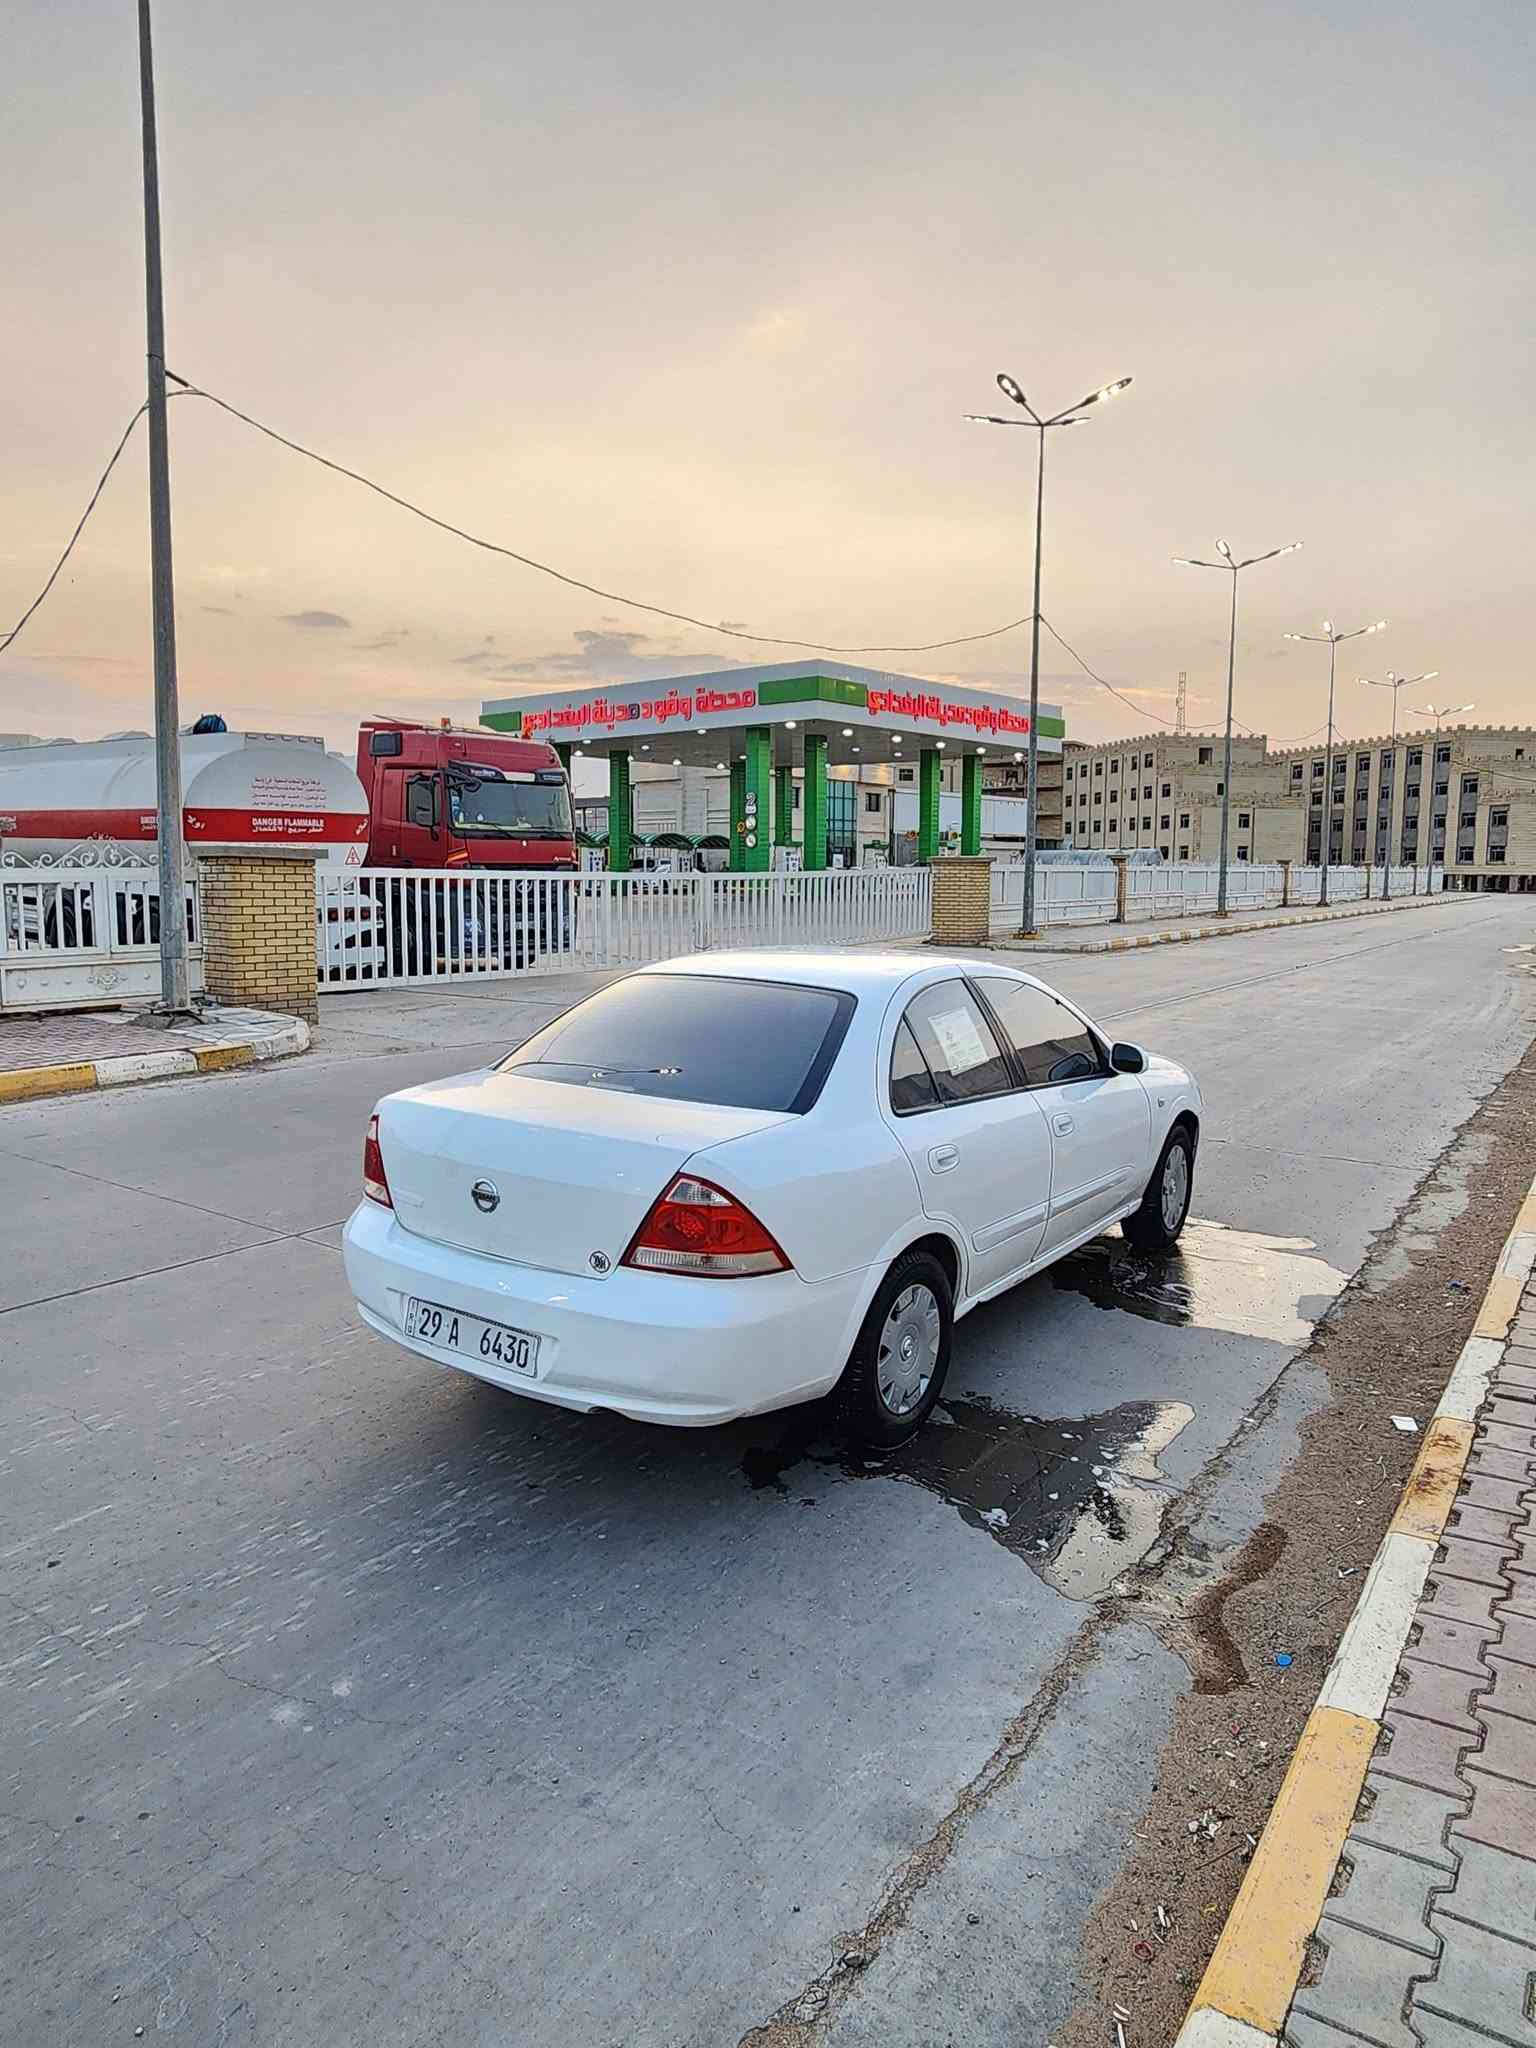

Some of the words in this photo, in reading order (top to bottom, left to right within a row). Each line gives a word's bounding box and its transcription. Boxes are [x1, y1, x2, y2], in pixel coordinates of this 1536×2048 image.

[592, 697, 640, 730] مدينة
[640, 688, 692, 723] وقود
[696, 687, 756, 713] محطة
[867, 690, 925, 721] البغدادي
[925, 695, 964, 726] مدينة
[522, 703, 591, 737] البغدادي
[964, 704, 998, 735] وقود
[999, 708, 1030, 733] محطة
[252, 818, 283, 827] DANGER
[284, 818, 324, 828] FLAMMABLE
[419, 1308, 442, 1338] 29
[448, 1317, 459, 1346] A
[480, 1328, 529, 1368] 6430
